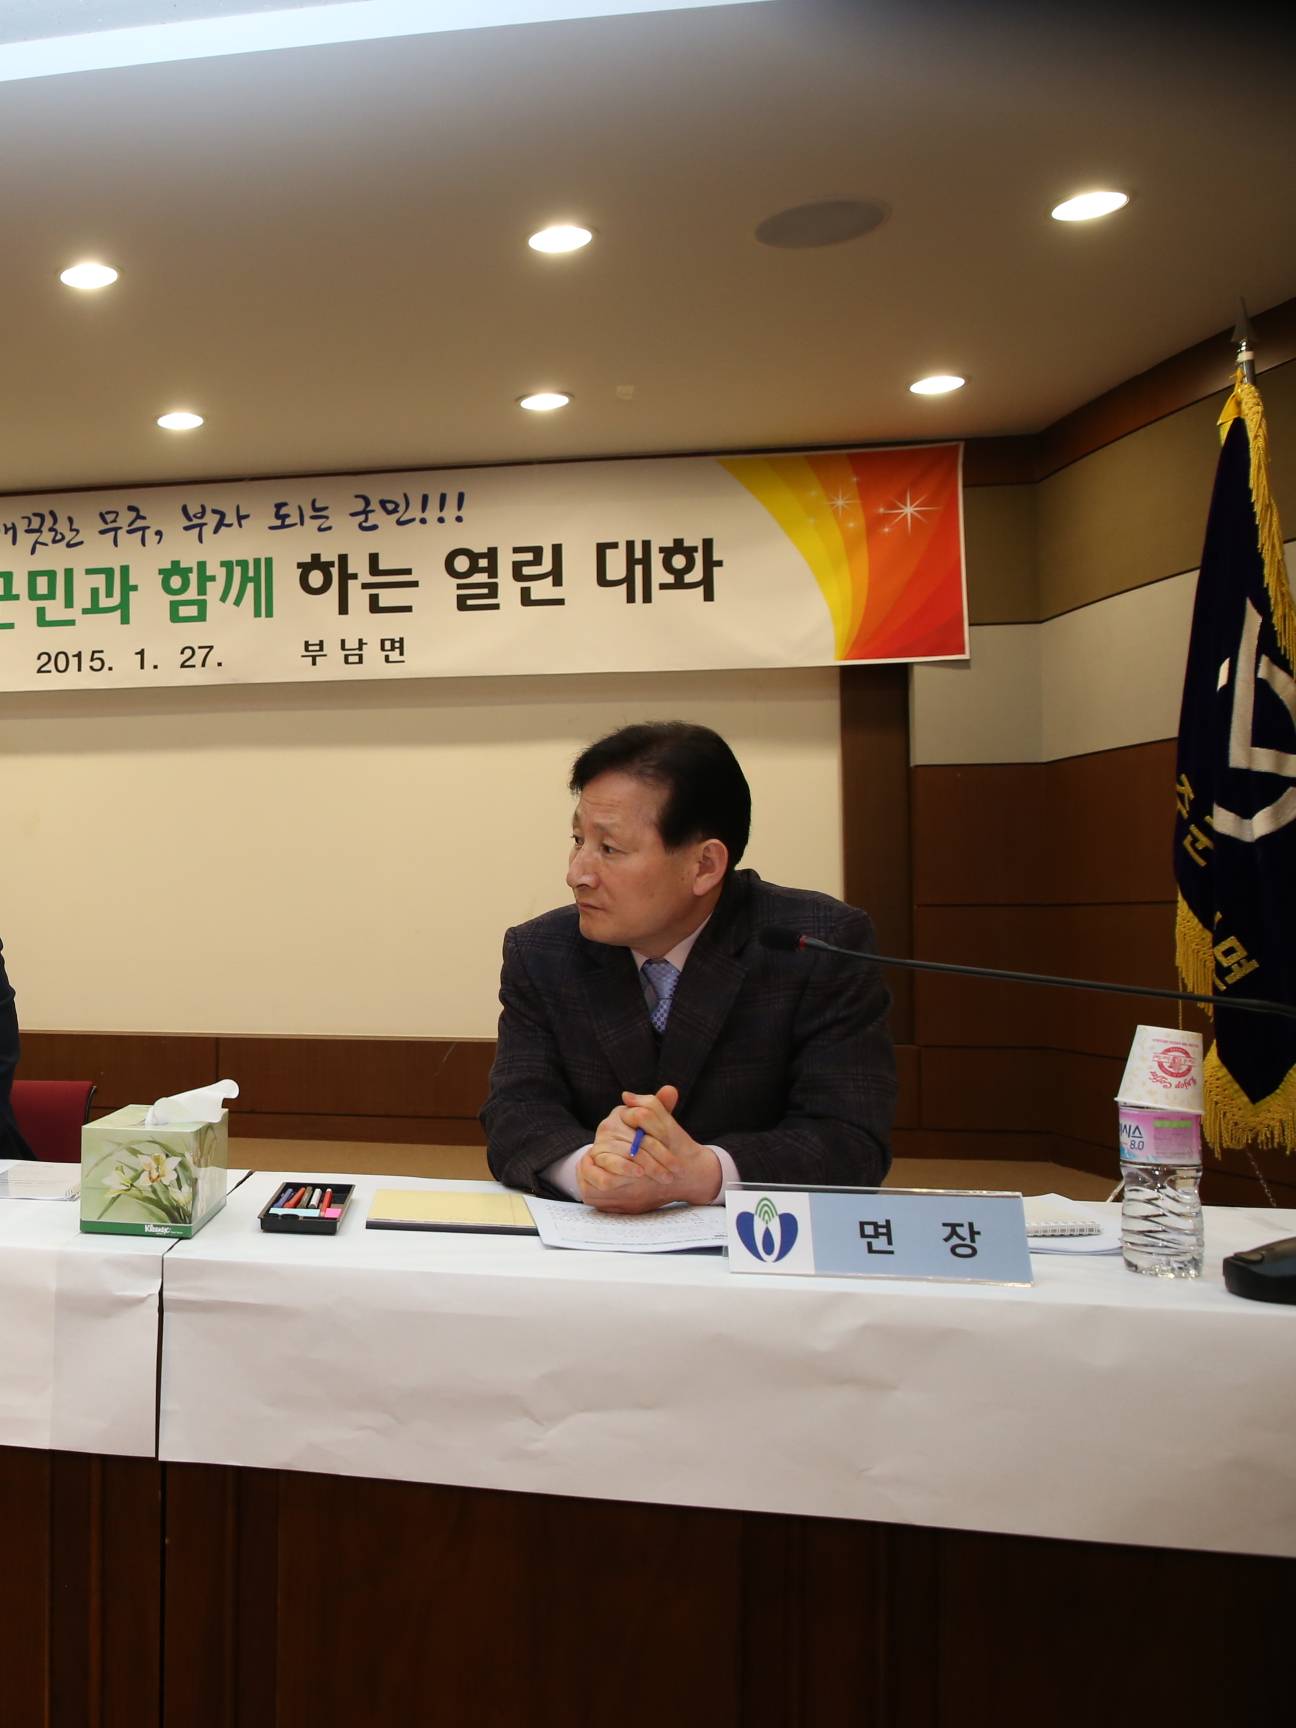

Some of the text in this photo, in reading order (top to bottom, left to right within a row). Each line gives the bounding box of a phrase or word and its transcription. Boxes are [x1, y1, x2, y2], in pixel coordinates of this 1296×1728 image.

[98, 504, 163, 548] 무주,
[181, 503, 251, 544] 부자
[267, 497, 333, 533] 되는
[348, 491, 466, 532] 군민!!!
[158, 556, 274, 624] 함께
[296, 552, 420, 616] 하는
[444, 543, 566, 612] 열린
[595, 537, 724, 605] 대화
[36, 645, 224, 674] 2015. 1. 27.
[301, 636, 406, 666] 부남면
[1130, 1140, 1145, 1151] 8.0
[858, 1218, 981, 1259] 면 장
